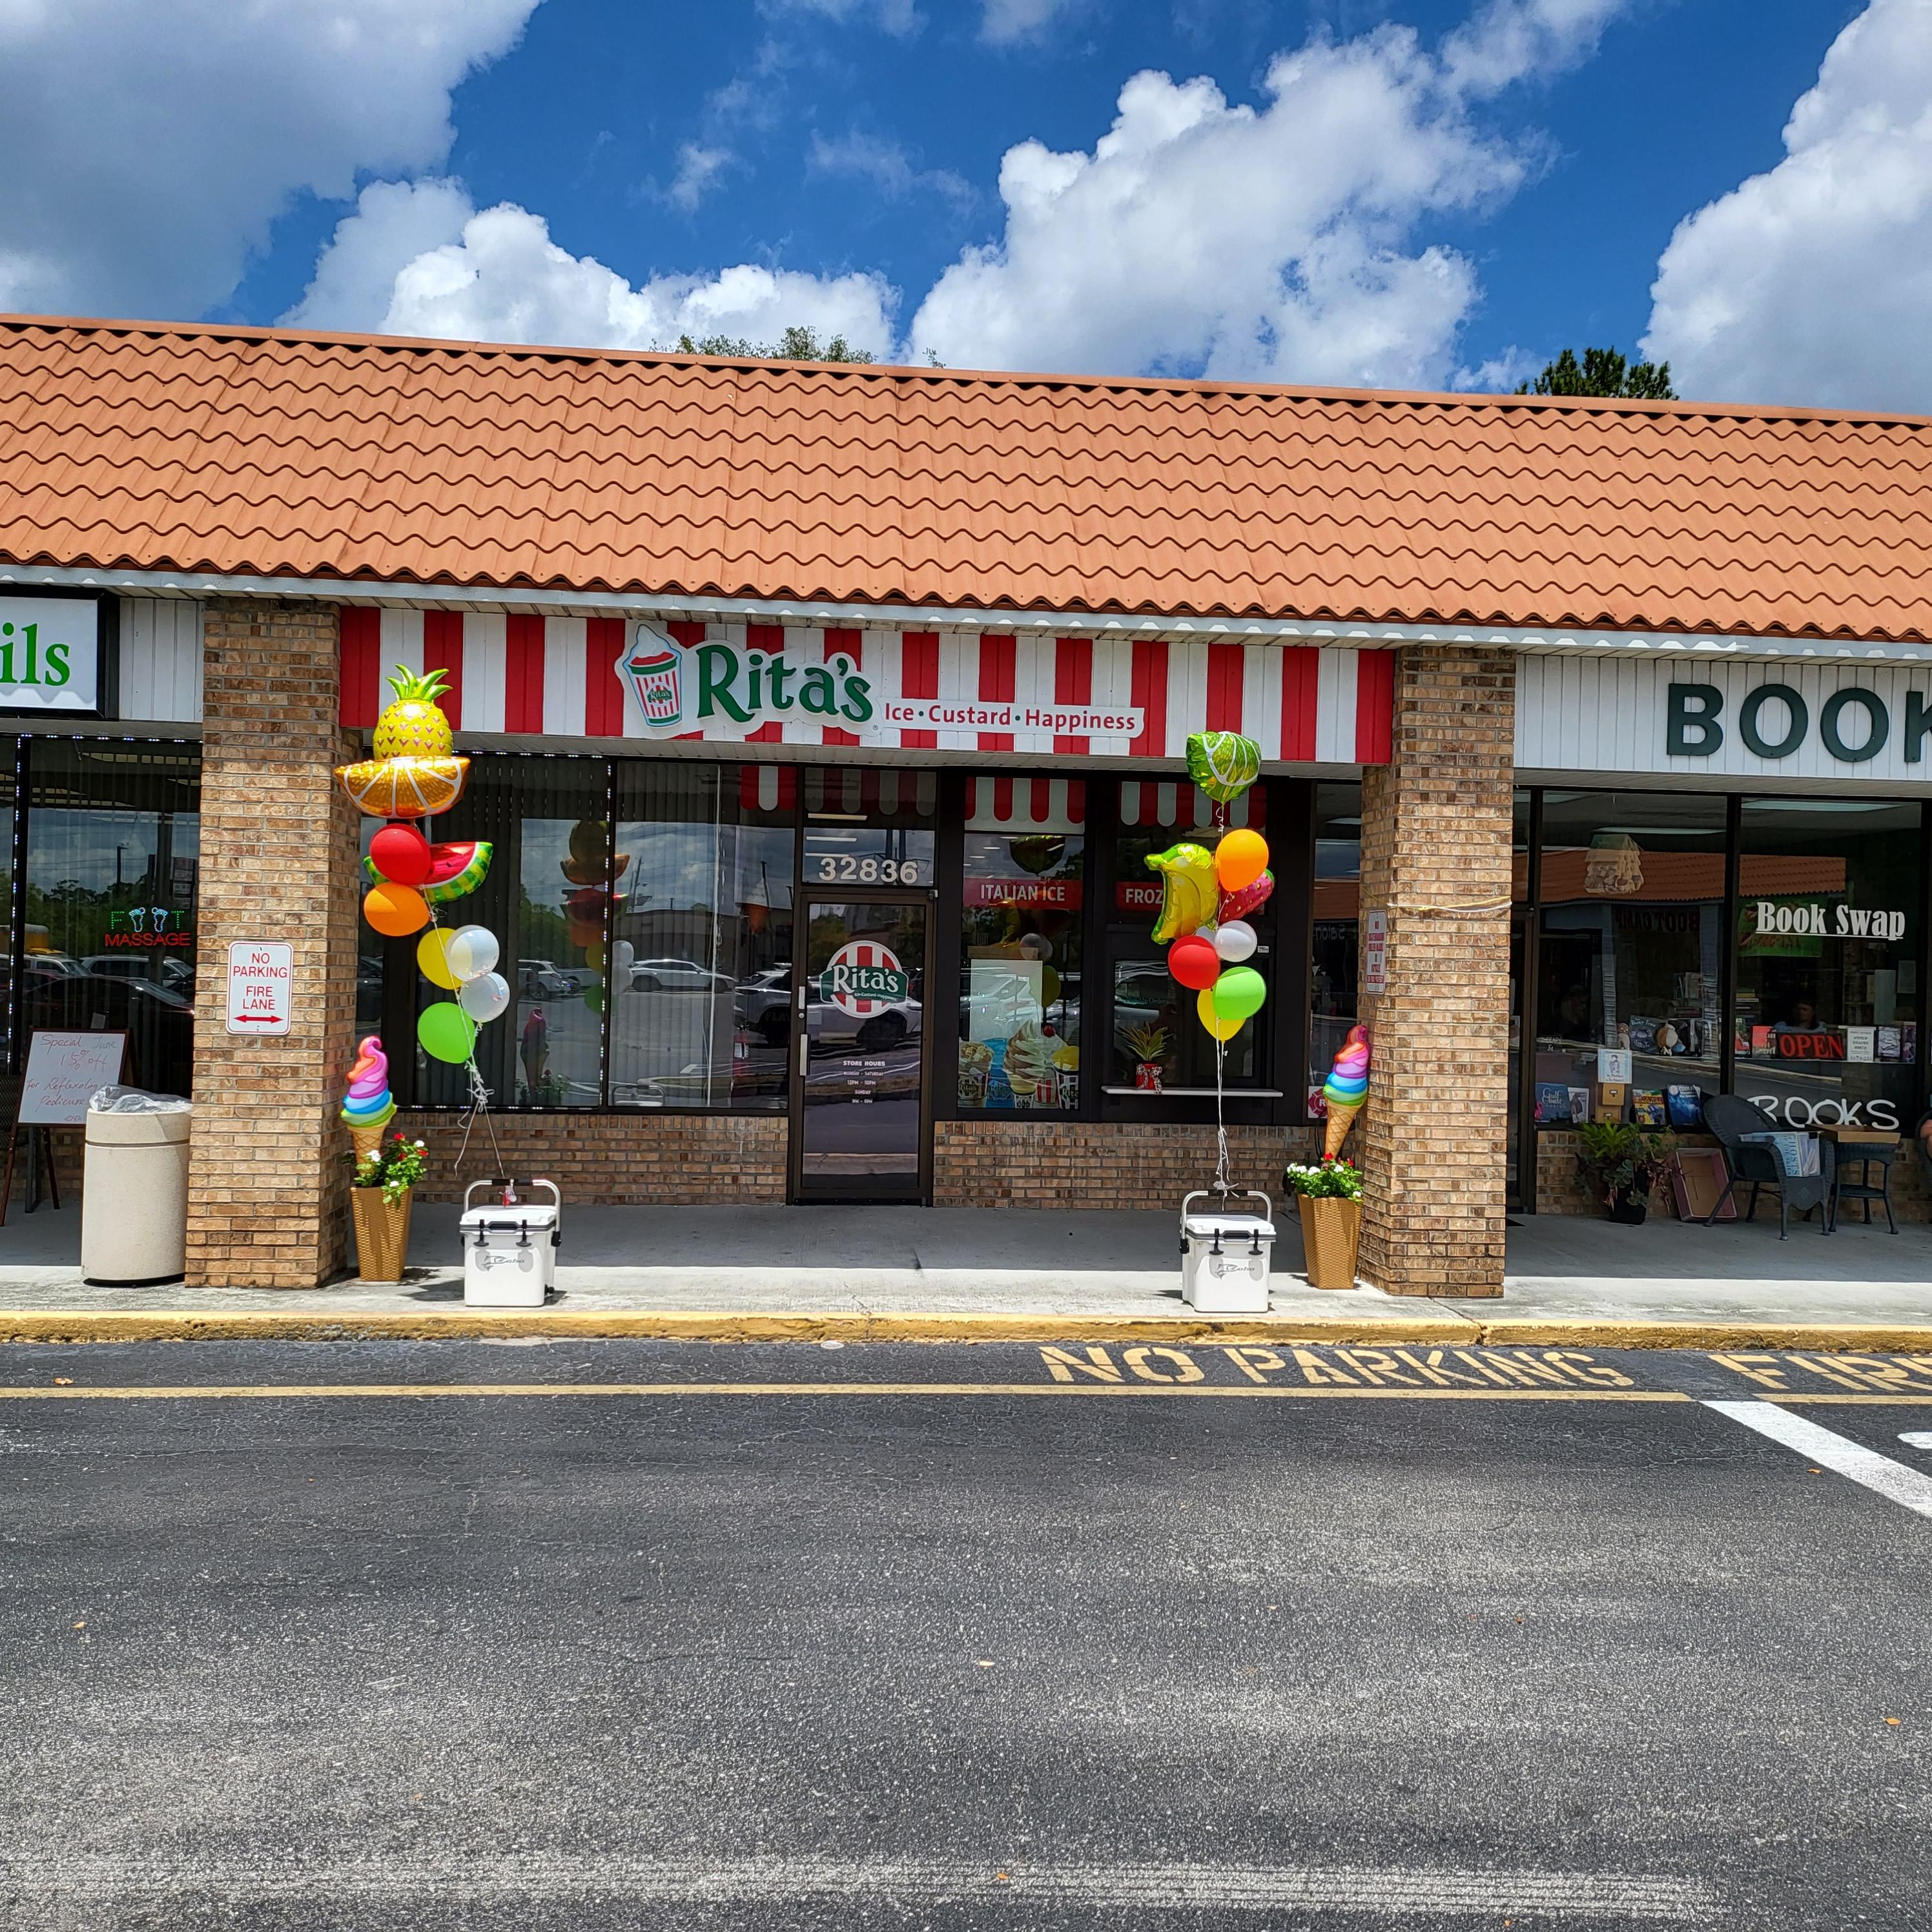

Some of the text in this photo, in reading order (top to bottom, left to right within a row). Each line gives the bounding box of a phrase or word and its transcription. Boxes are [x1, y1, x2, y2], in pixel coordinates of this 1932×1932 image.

[696, 644, 874, 723] Rita's
[1667, 683, 1932, 763] BOOK
[819, 857, 918, 885] 32836
[980, 884, 1065, 901] ITALIAN ICE
[110, 907, 185, 932] FT
[1756, 901, 1827, 934] Book
[1836, 904, 1906, 941] Swap
[105, 932, 192, 947] MASSAGE
[251, 952, 270, 964] NO
[232, 965, 288, 978] PARKING
[832, 964, 899, 994] Rita's
[246, 985, 274, 998] FIRE
[242, 998, 276, 1011] LANE
[41, 1034, 118, 1054] Special June
[1780, 1034, 1845, 1058] OPEN
[1038, 1346, 1635, 1386] NO PARKING
